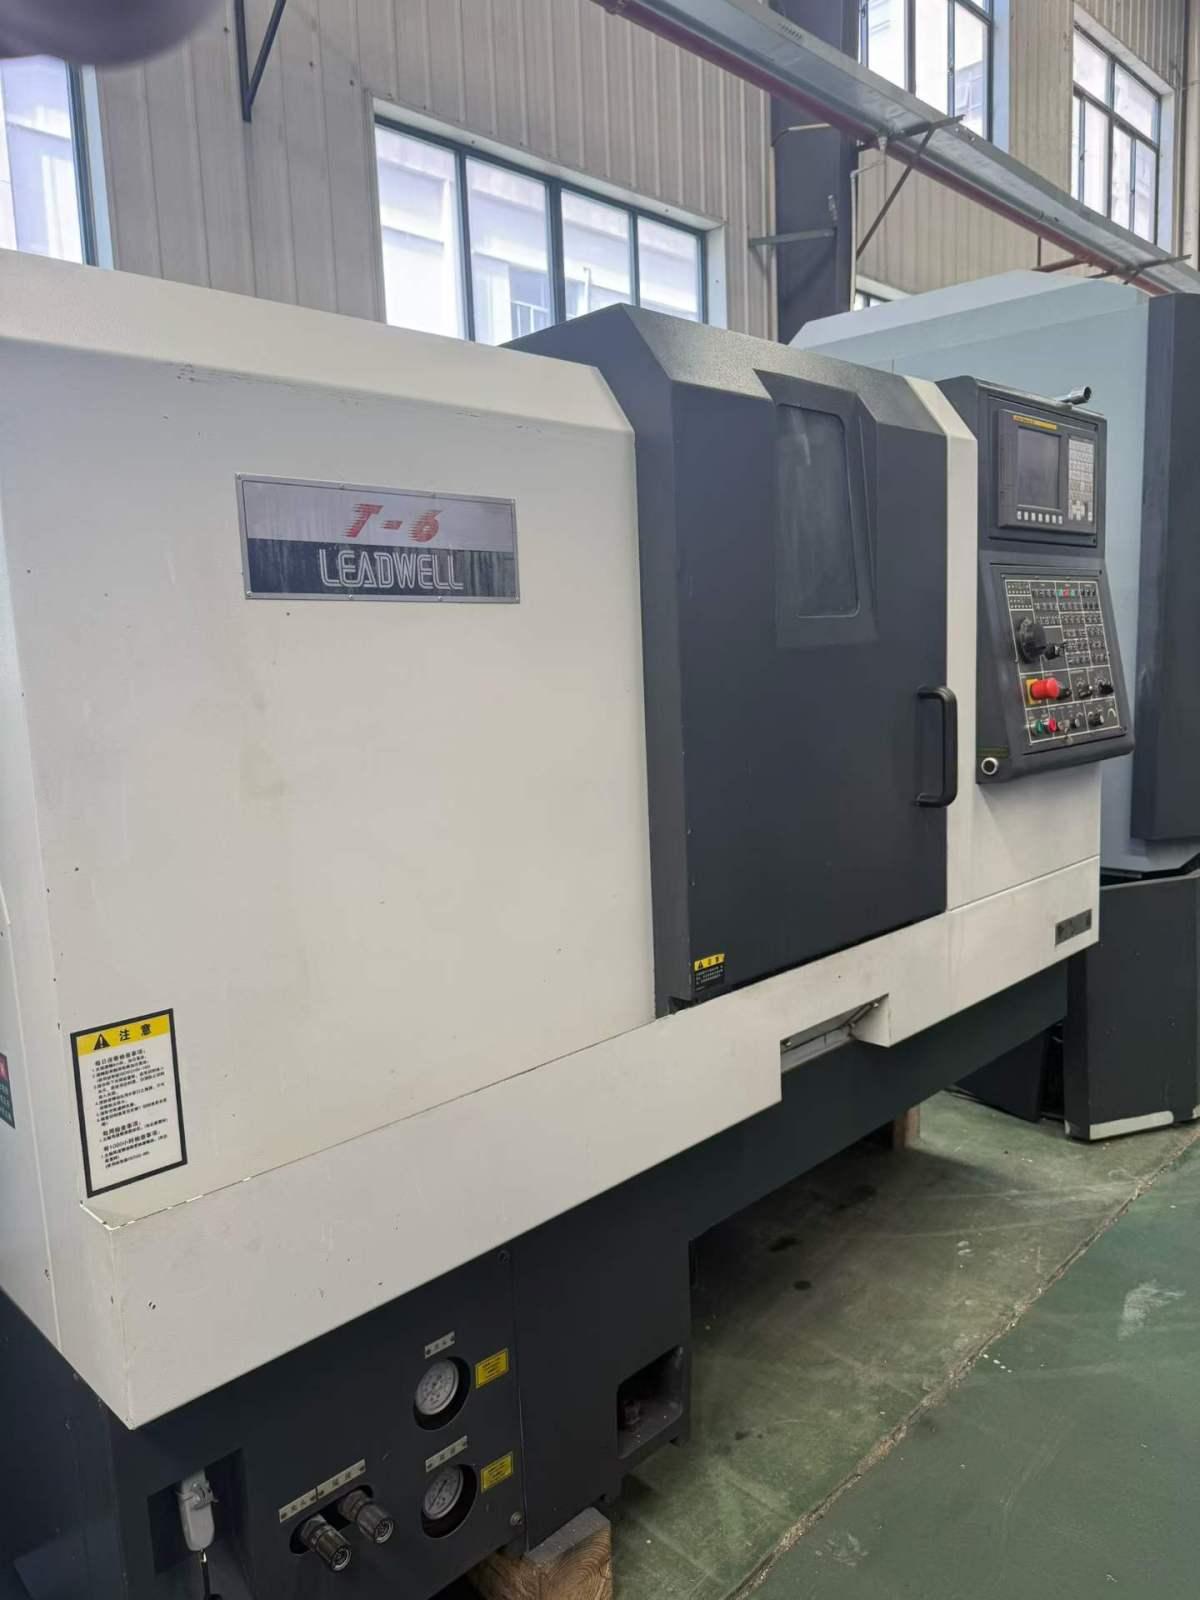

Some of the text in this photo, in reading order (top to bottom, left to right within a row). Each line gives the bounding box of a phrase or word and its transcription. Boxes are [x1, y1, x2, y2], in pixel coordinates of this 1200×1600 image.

[343, 502, 443, 543] T-6
[319, 549, 464, 590] LEADWELL
[119, 1023, 152, 1042] 注意
